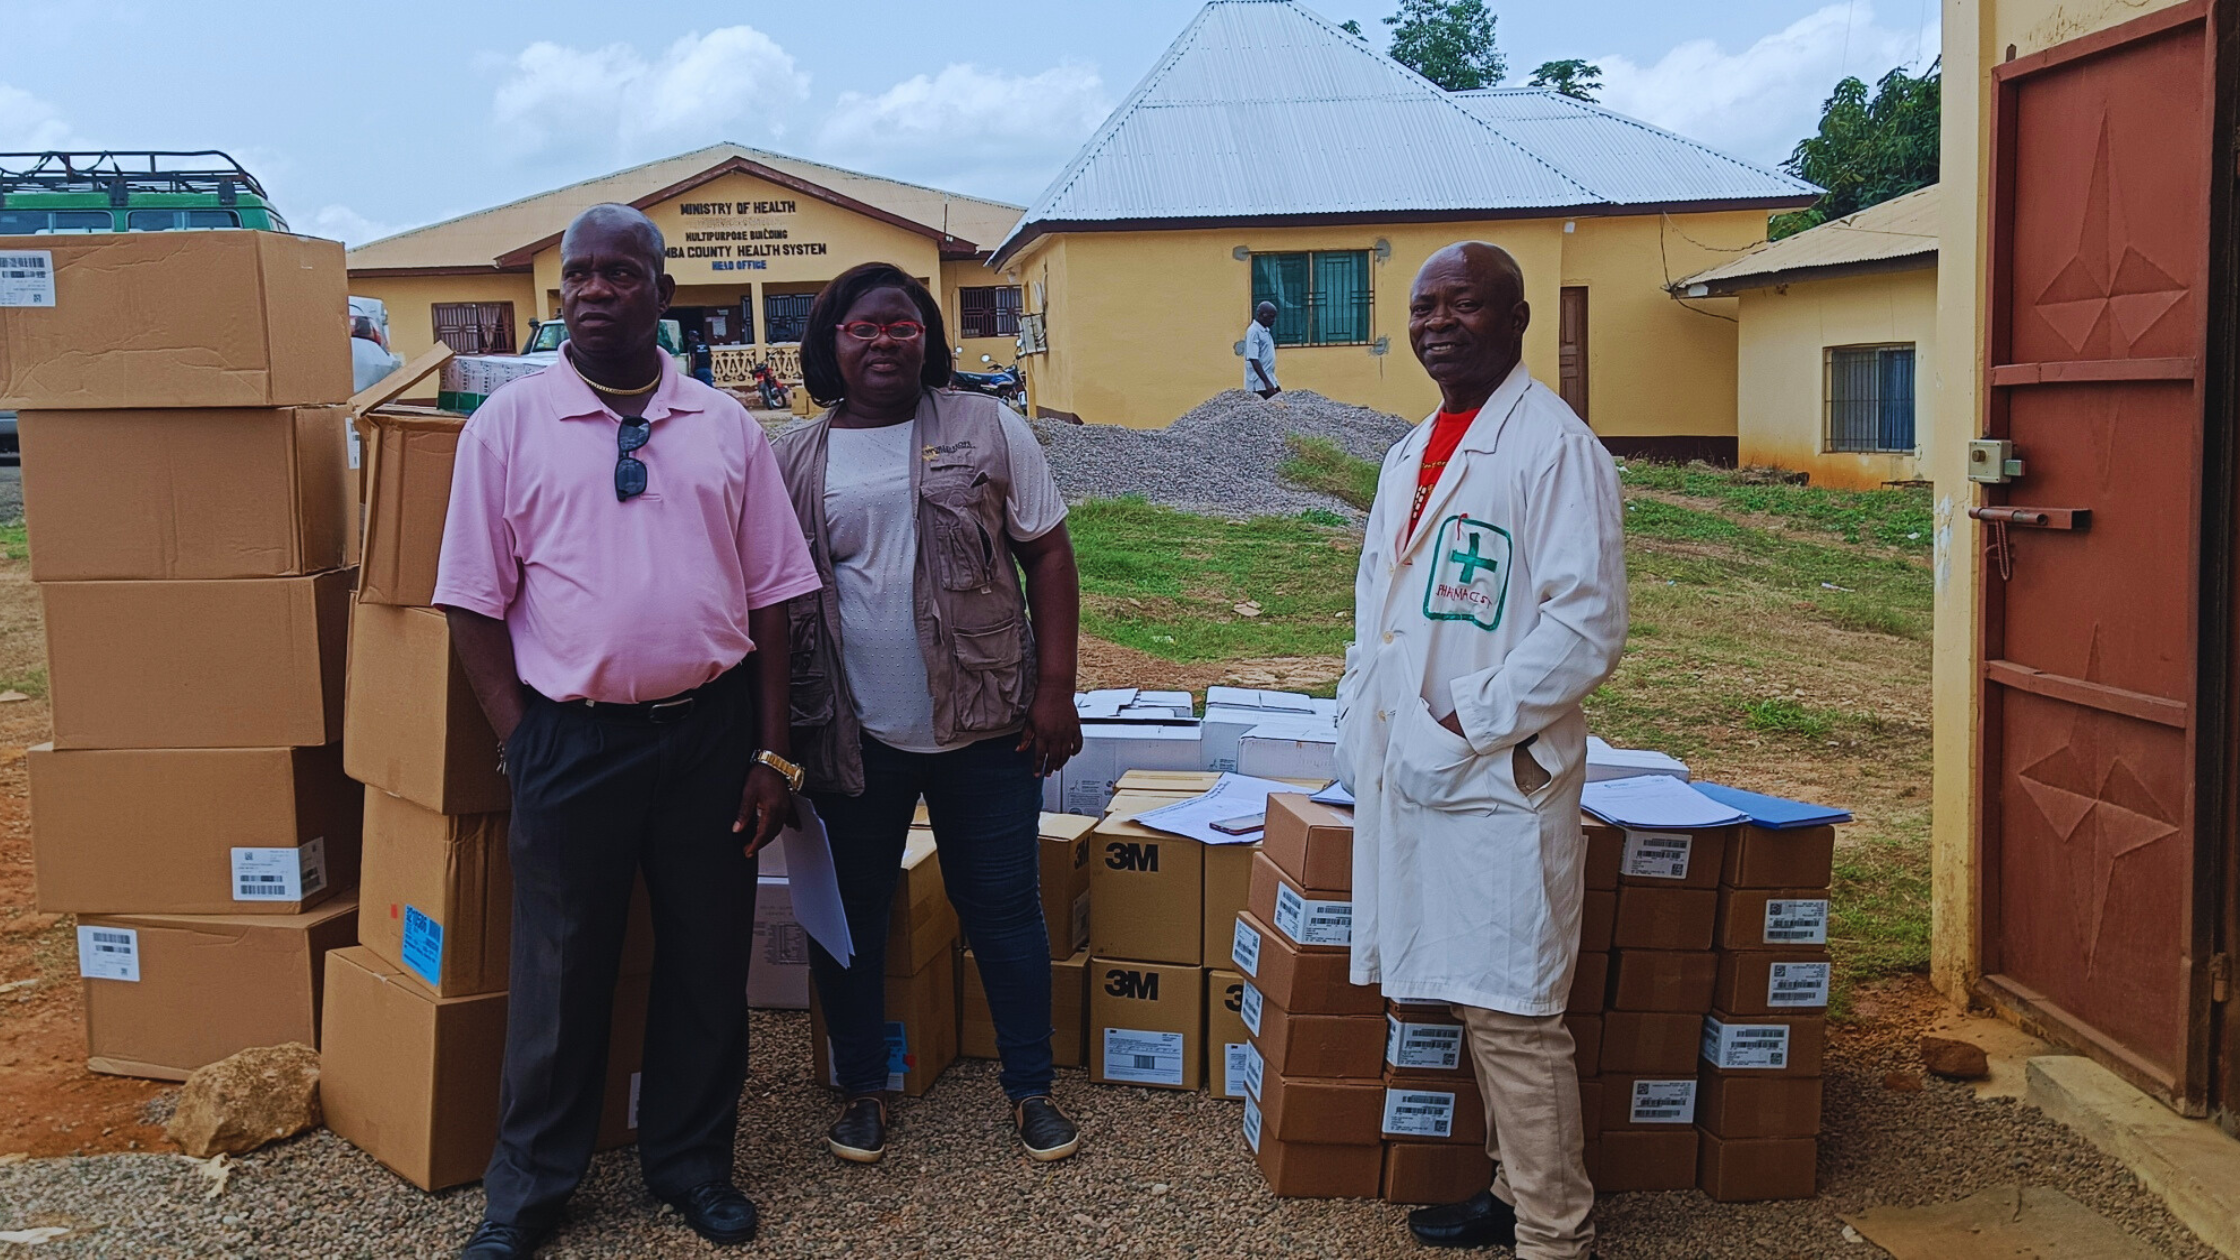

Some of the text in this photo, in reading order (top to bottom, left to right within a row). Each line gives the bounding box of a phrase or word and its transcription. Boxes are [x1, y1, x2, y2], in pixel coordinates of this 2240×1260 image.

[680, 200, 796, 215] MINISTRY OF HEALTH
[685, 228, 788, 242] MULTIPURPOSE BUILDING
[687, 245, 732, 258] COUNTY
[737, 244, 780, 257] HEALTH
[782, 243, 827, 255] SYSTEM
[712, 259, 767, 271] HEAD OFFICE
[1104, 842, 1159, 872] 3M
[1104, 969, 1159, 1001] 3M
